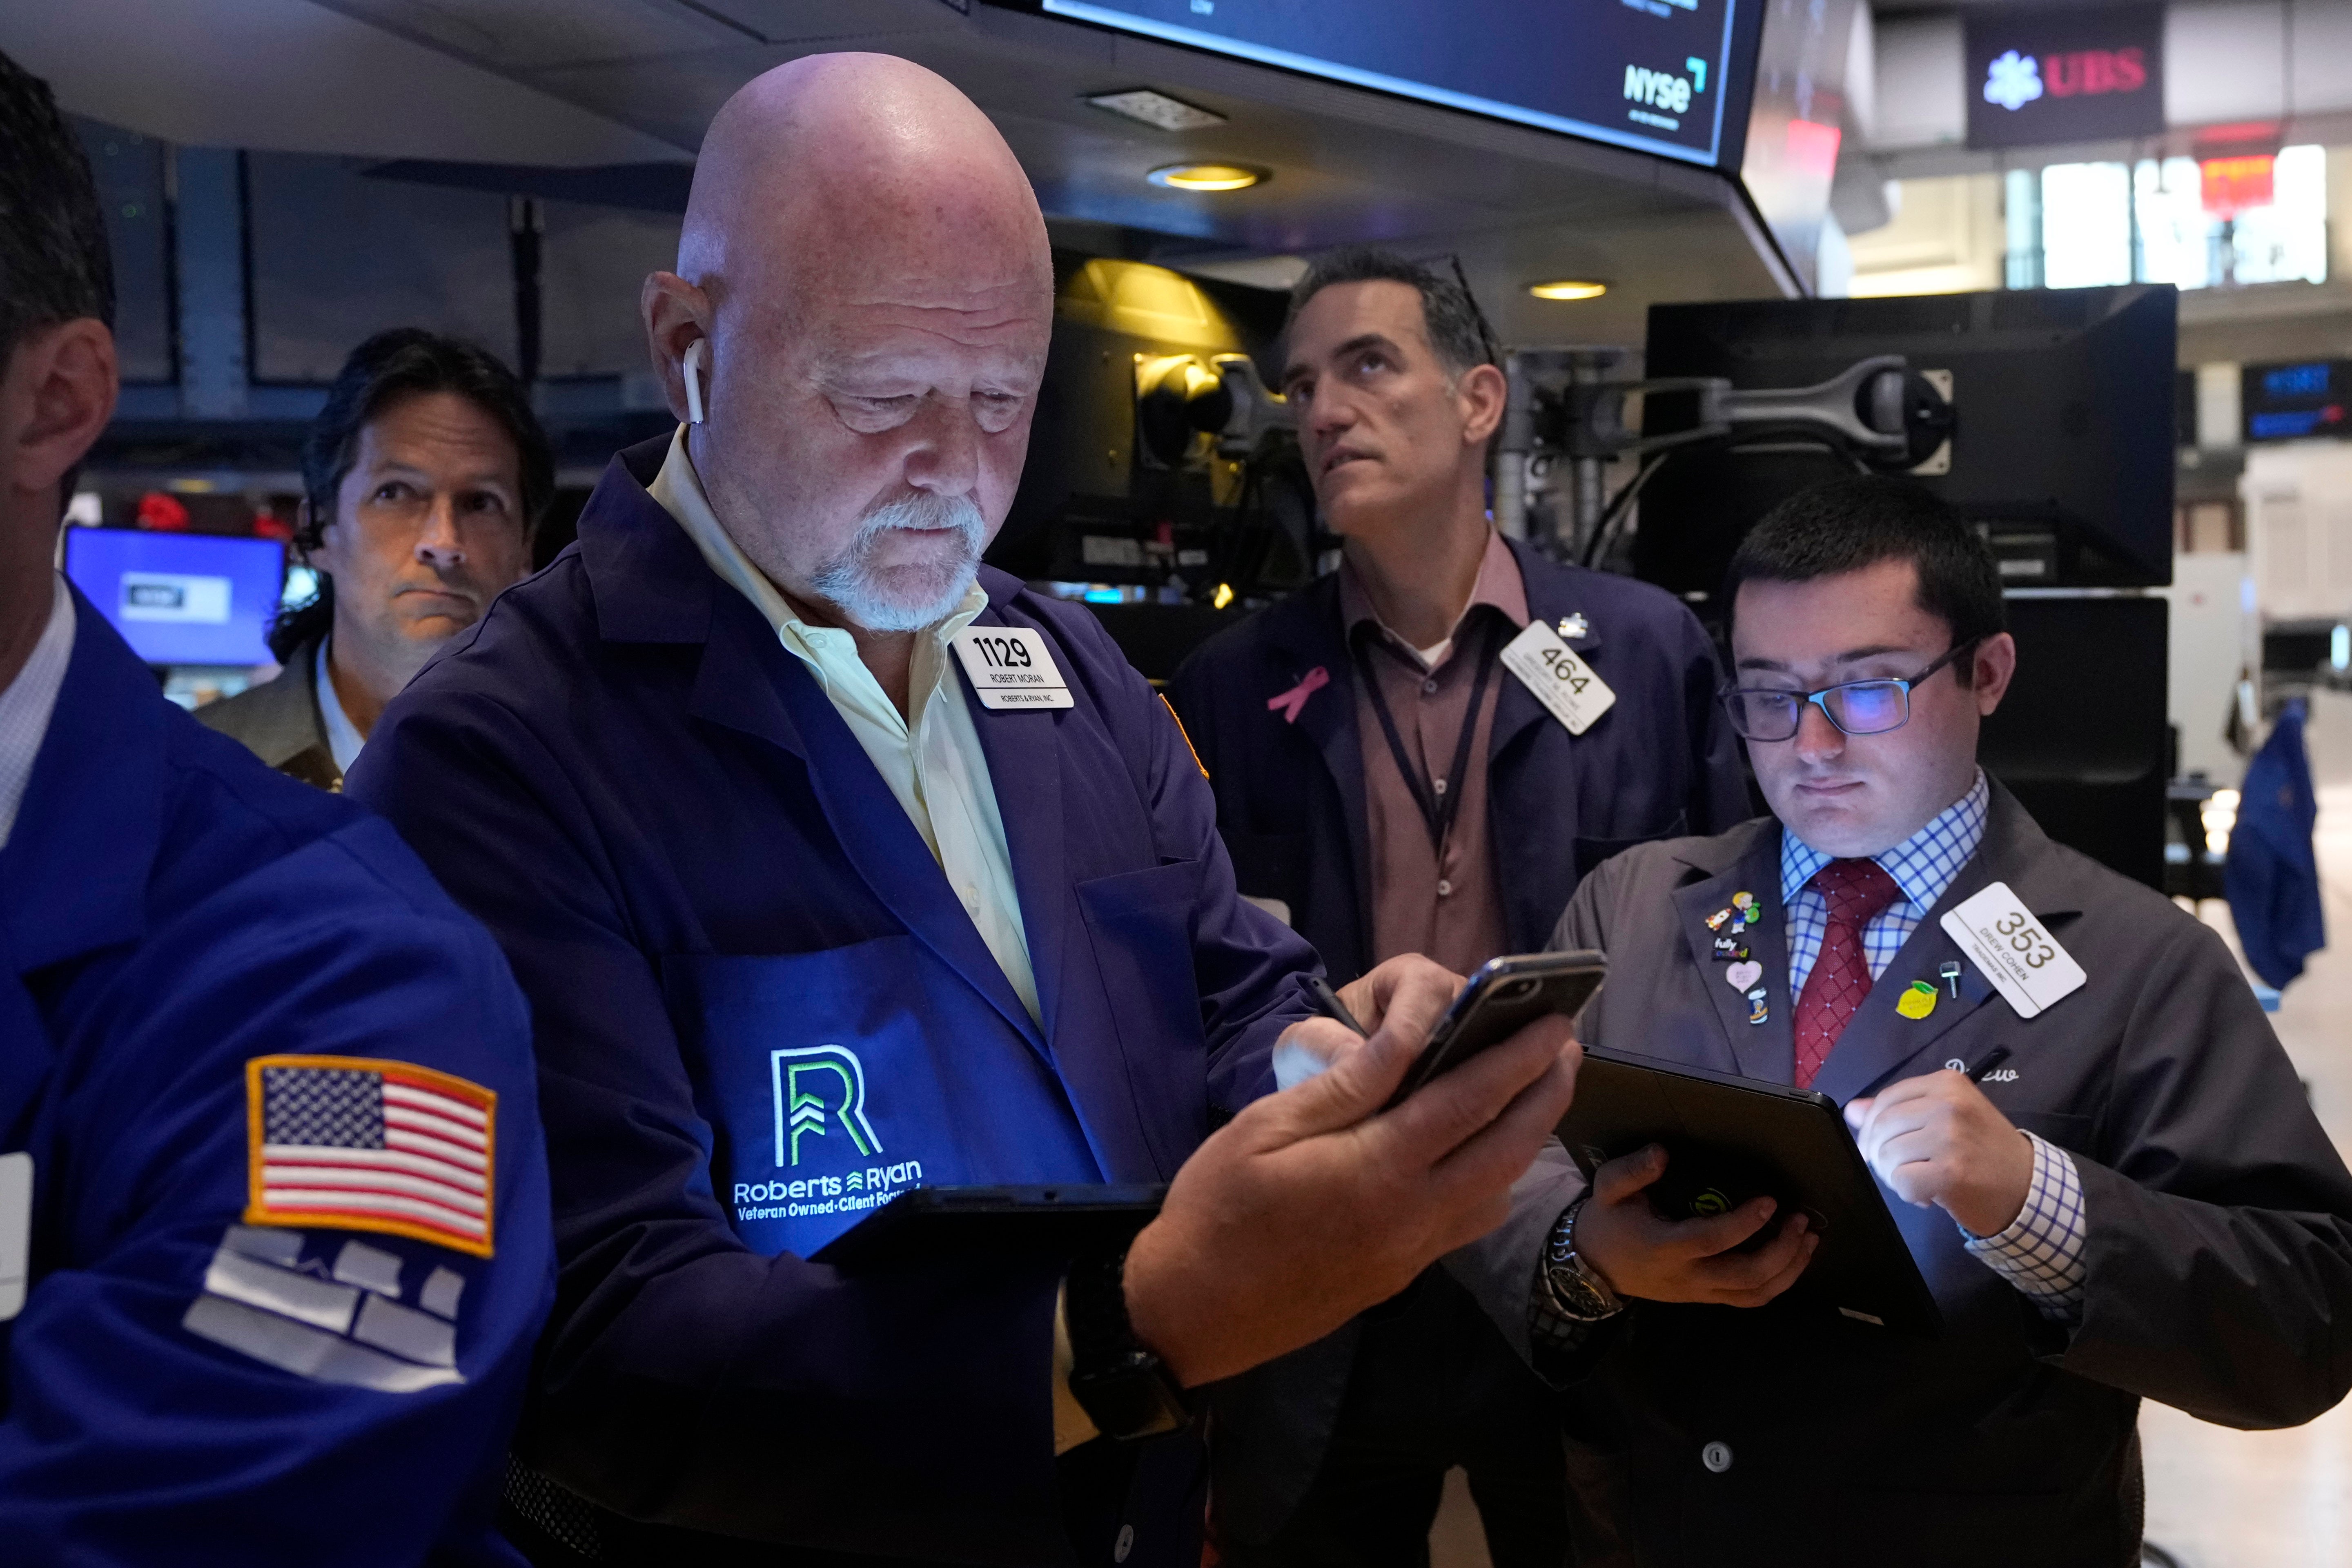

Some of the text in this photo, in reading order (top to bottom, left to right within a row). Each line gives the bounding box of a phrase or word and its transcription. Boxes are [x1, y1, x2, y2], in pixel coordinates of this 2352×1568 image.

[2045, 47, 2145, 98] UBS
[973, 637, 1031, 667] 1129
[1542, 649, 1590, 695] 464
[990, 674, 1045, 683] ROBERT MORAN
[1980, 927, 2029, 981] DREW COHEN
[1996, 912, 2055, 969] 353
[734, 1176, 842, 1204] Roberts
[866, 1160, 922, 1192] Ryan
[738, 1206, 786, 1221] Veteran
